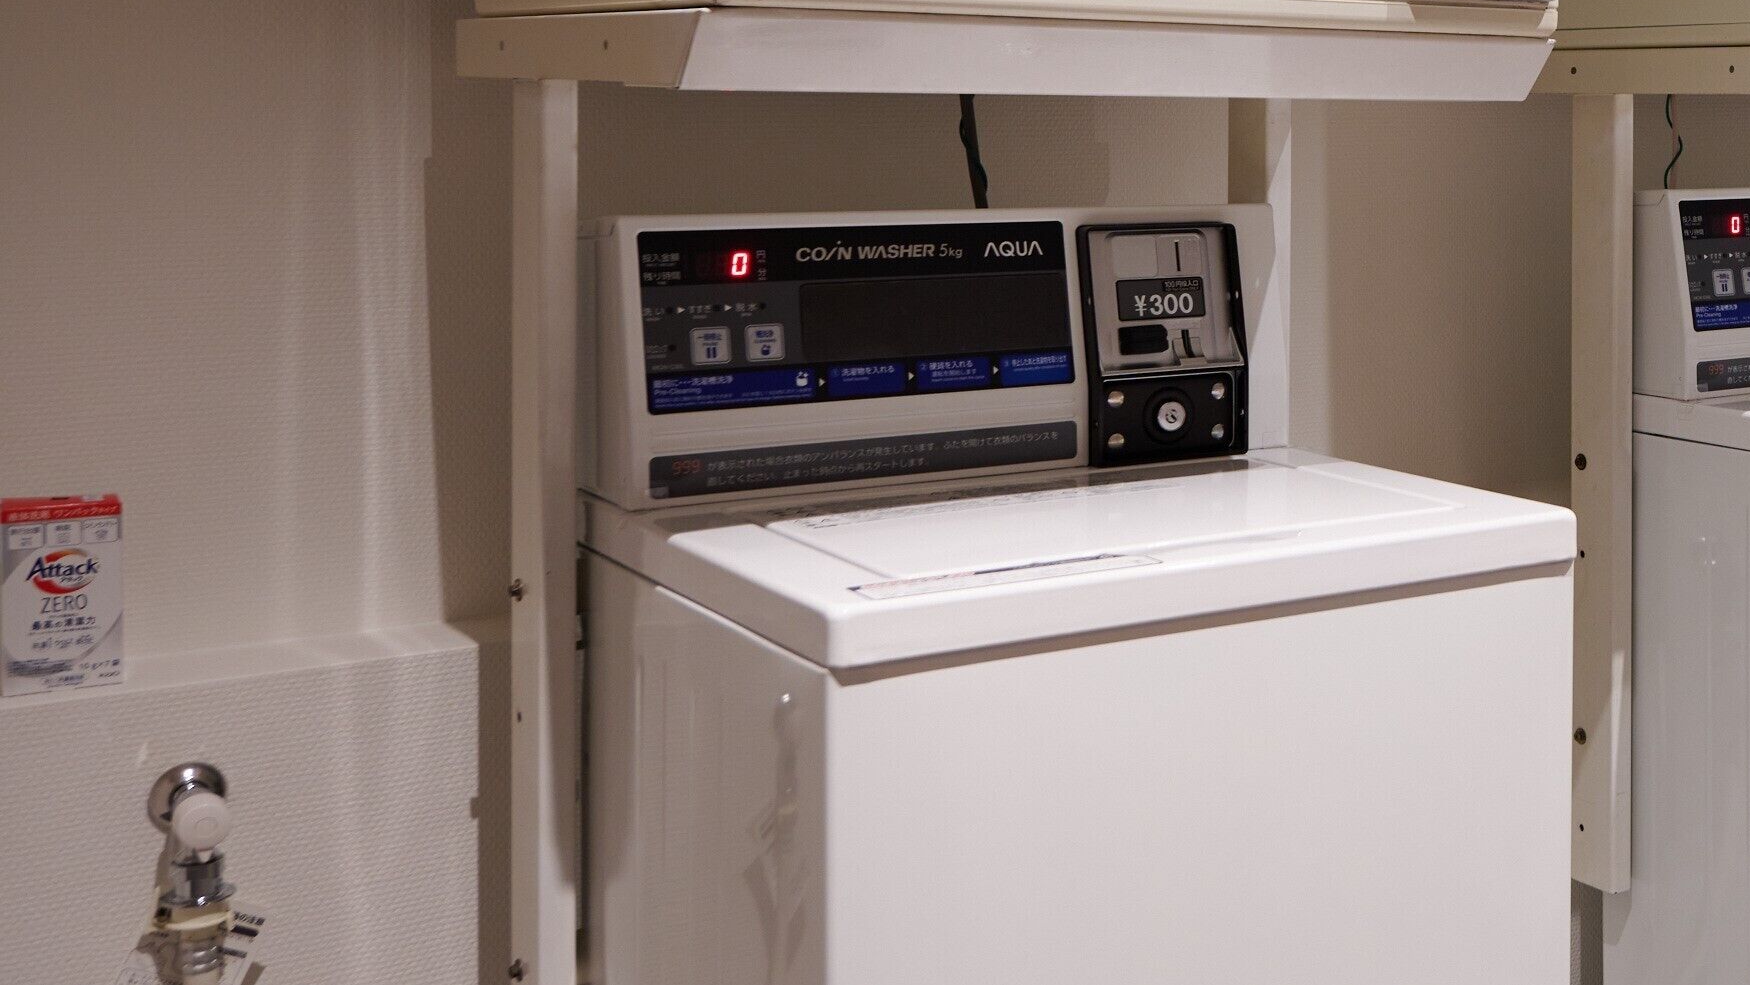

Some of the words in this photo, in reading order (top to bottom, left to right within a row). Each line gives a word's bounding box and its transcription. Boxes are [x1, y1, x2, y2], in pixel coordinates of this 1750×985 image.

[1731, 216, 1740, 233] 0
[858, 243, 935, 260] WASHER
[940, 243, 963, 260] 5kg
[984, 240, 1043, 258] AQUA
[731, 252, 748, 276] 0
[1134, 292, 1194, 316] ¥300
[26, 556, 99, 581] Attack
[41, 594, 88, 614] ZERO
